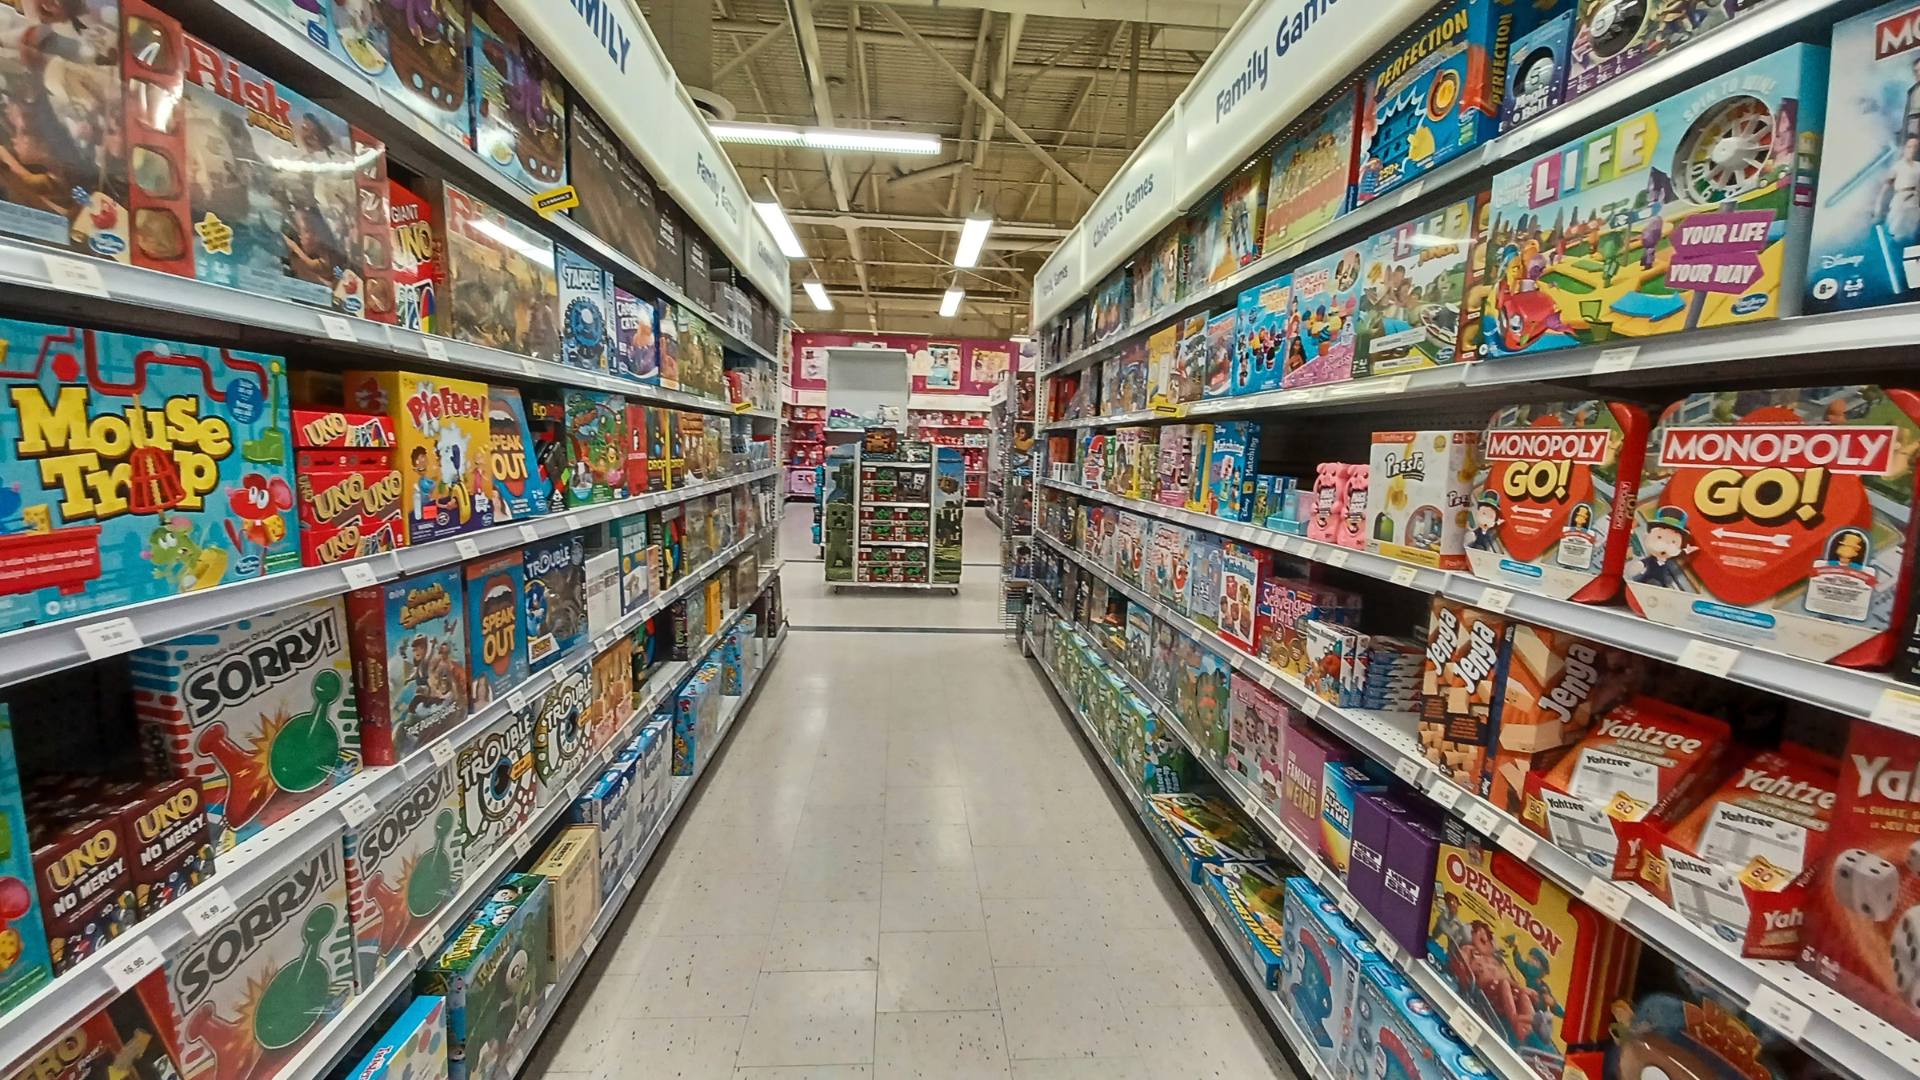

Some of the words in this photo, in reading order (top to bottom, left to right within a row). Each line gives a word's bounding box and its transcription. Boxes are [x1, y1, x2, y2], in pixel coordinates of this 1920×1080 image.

[1215, 45, 1269, 124] Family
[1276, 0, 1338, 57] Gam
[1376, 9, 1469, 95] PERFECTION
[1492, 13, 1513, 105] PERFECTION
[184, 33, 292, 127] Risk
[1513, 84, 1549, 112] Magic
[1684, 84, 1719, 122] SPIN
[1720, 79, 1740, 96] TO
[1742, 74, 1778, 95] WIN!
[1522, 96, 1549, 121] Ball
[1534, 120, 1648, 203] LIFE
[390, 204, 419, 223] GIANT
[1093, 203, 1123, 248] Children's
[1125, 173, 1154, 215] Games
[1681, 225, 1727, 246] YOUR
[1728, 222, 1768, 243] LIFE
[566, 266, 601, 290] TAPPLE
[1295, 270, 1329, 290] CUPCAKE
[1304, 282, 1327, 296] PARTY
[1669, 264, 1712, 284] YOUR
[1714, 264, 1757, 285] WAY
[8, 383, 233, 458] Mouse
[406, 390, 441, 429] Pie
[439, 386, 487, 422] Face!
[302, 412, 348, 446] UNO
[1489, 431, 1606, 459] MONOPOLY
[1666, 432, 1889, 466] MONOPOLY
[491, 452, 529, 481] OUT
[1245, 437, 1259, 477] Matching
[313, 472, 365, 523] UNO
[361, 469, 402, 517] UNO
[1503, 459, 1571, 499] GO!
[1693, 466, 1826, 522] GO!
[315, 526, 360, 566] UNO
[527, 543, 571, 579] TROUBLE
[483, 605, 516, 635] SPEAK
[1263, 588, 1313, 620] Scavenger
[1270, 605, 1294, 626] Hunt
[483, 625, 516, 665] OUT
[1427, 607, 1458, 676] Jenga
[1453, 620, 1498, 694] Jenga
[183, 658, 199, 671] The
[189, 617, 337, 719] SORRY!
[1538, 643, 1598, 723] Jenga
[461, 714, 533, 790] TROUBLE
[1597, 718, 1702, 755] Yahtzee
[1287, 760, 1311, 793] FAMILY
[1586, 755, 1632, 768] Yahtzee
[134, 787, 199, 844] UNO
[1285, 778, 1317, 820] WEIRD
[1324, 795, 1349, 819] AUDIO
[1324, 804, 1349, 831] GAME
[1546, 797, 1585, 812] Yahtzee
[1615, 801, 1634, 814] 80
[1719, 809, 1775, 829] Yahtzee
[141, 844, 163, 867] NO
[165, 813, 207, 848] MERCY
[361, 766, 453, 874] SORRY!
[45, 829, 118, 893] UNO
[1668, 856, 1712, 877] Yahtzee
[1751, 866, 1773, 883] 80
[53, 892, 78, 918] NO
[80, 857, 127, 899] MERCY
[1446, 853, 1563, 957] OPERATION
[181, 847, 335, 1004] SORRY!
